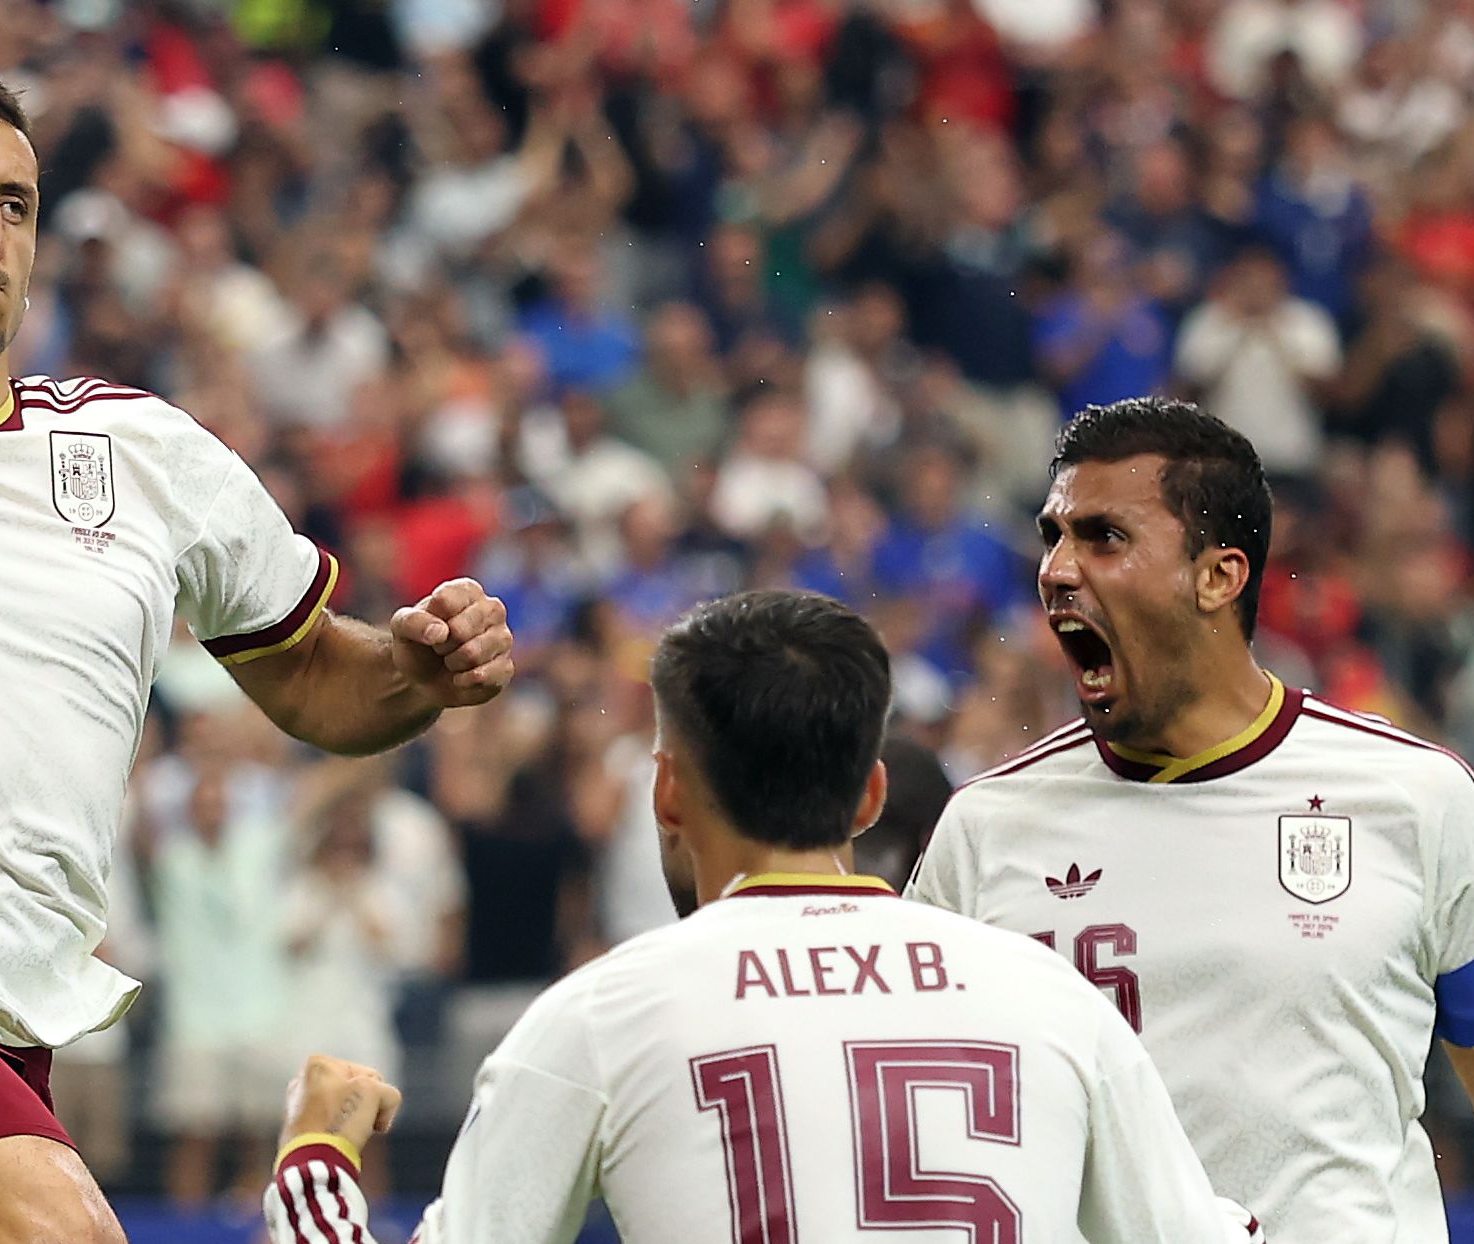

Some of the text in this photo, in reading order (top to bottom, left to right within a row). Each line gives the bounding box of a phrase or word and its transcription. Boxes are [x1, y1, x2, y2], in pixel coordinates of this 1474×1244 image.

[735, 942, 966, 999] ALEX B.
[1028, 923, 1142, 1036] 6
